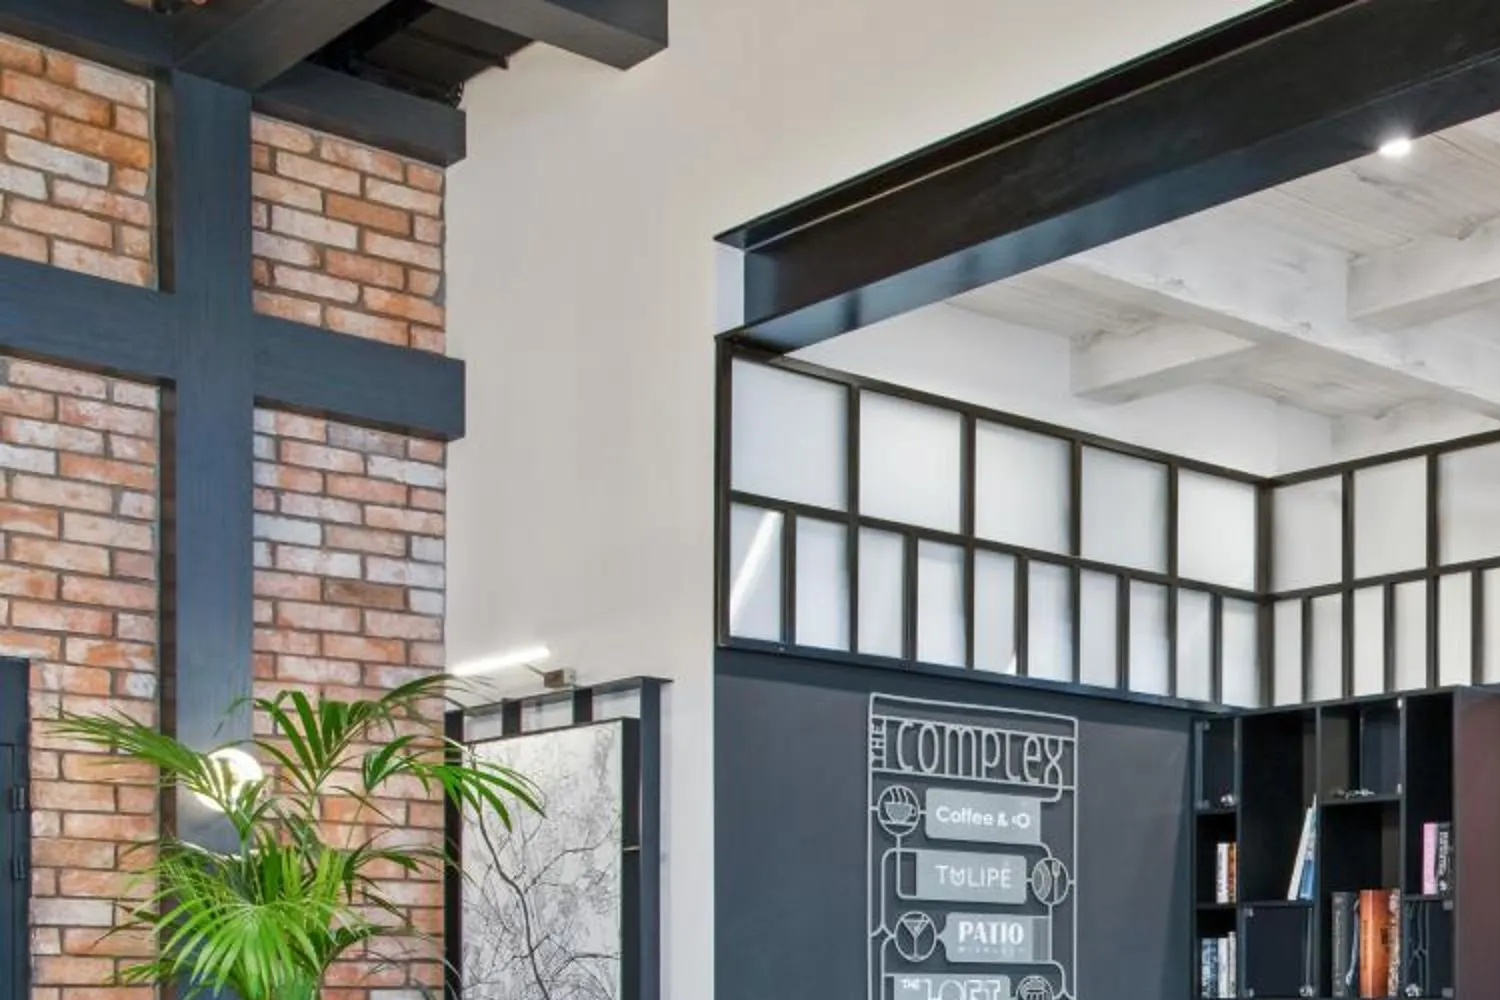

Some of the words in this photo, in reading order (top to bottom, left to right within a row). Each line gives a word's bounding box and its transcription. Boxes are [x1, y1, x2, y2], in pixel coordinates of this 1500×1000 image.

[936, 805, 994, 826] Coffee
[997, 811, 1008, 827] &
[958, 921, 1024, 946] PATIO
